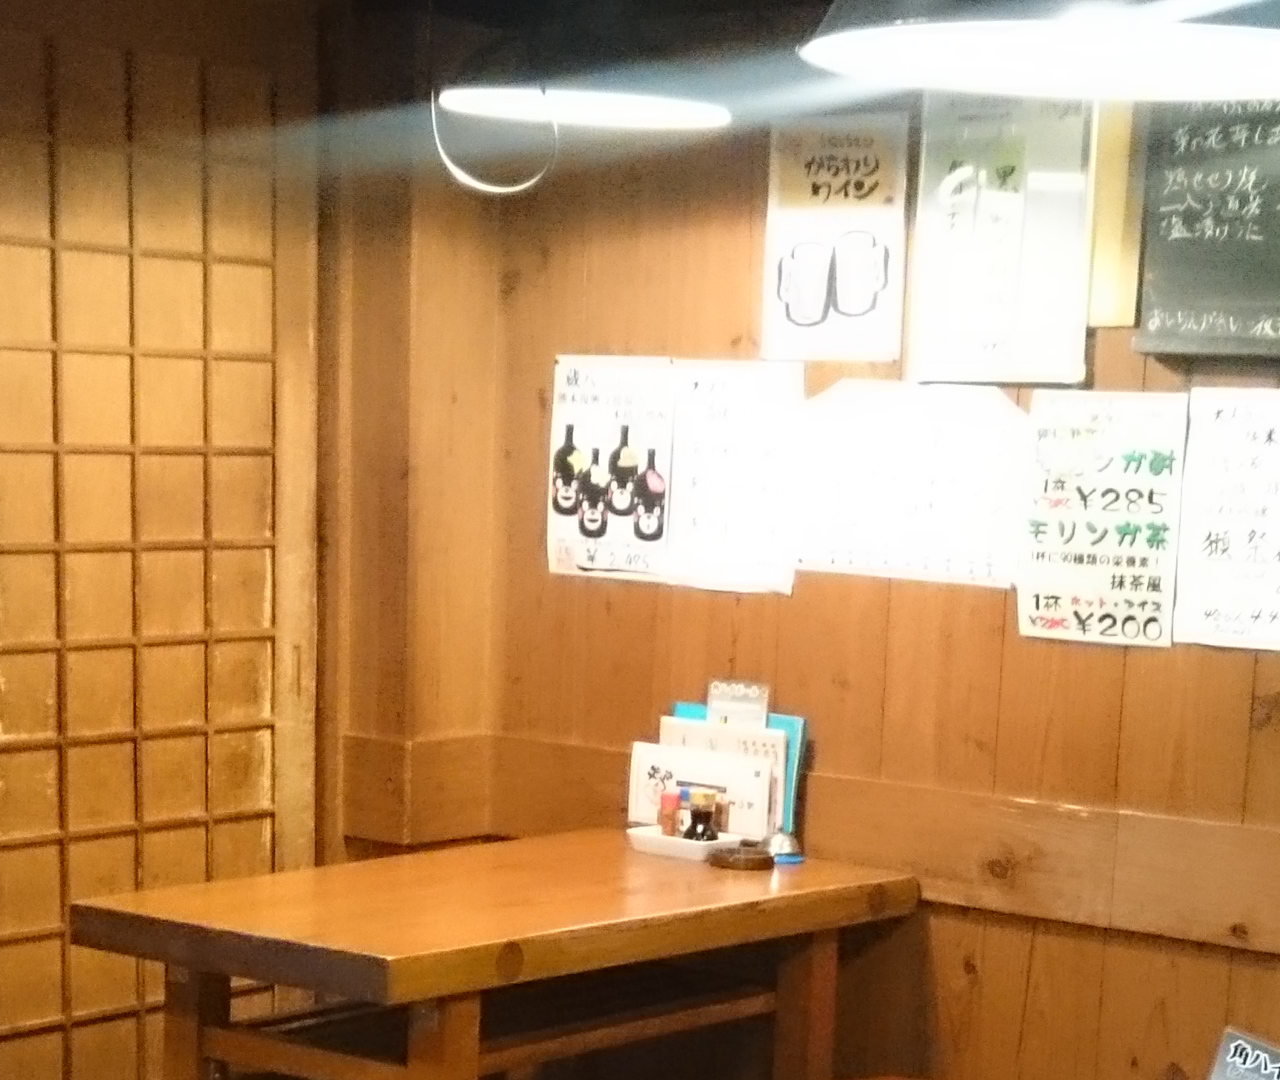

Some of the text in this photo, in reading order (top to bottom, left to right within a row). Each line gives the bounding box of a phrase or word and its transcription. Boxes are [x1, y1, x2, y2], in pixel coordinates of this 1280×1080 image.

[811, 178, 880, 203] ワイン
[1075, 484, 1168, 514] ¥285
[1028, 518, 1170, 551] モリンガ茶
[1111, 573, 1162, 593] 抹茶風
[1033, 593, 1062, 612] 1杯
[1073, 609, 1163, 642] ¥200
